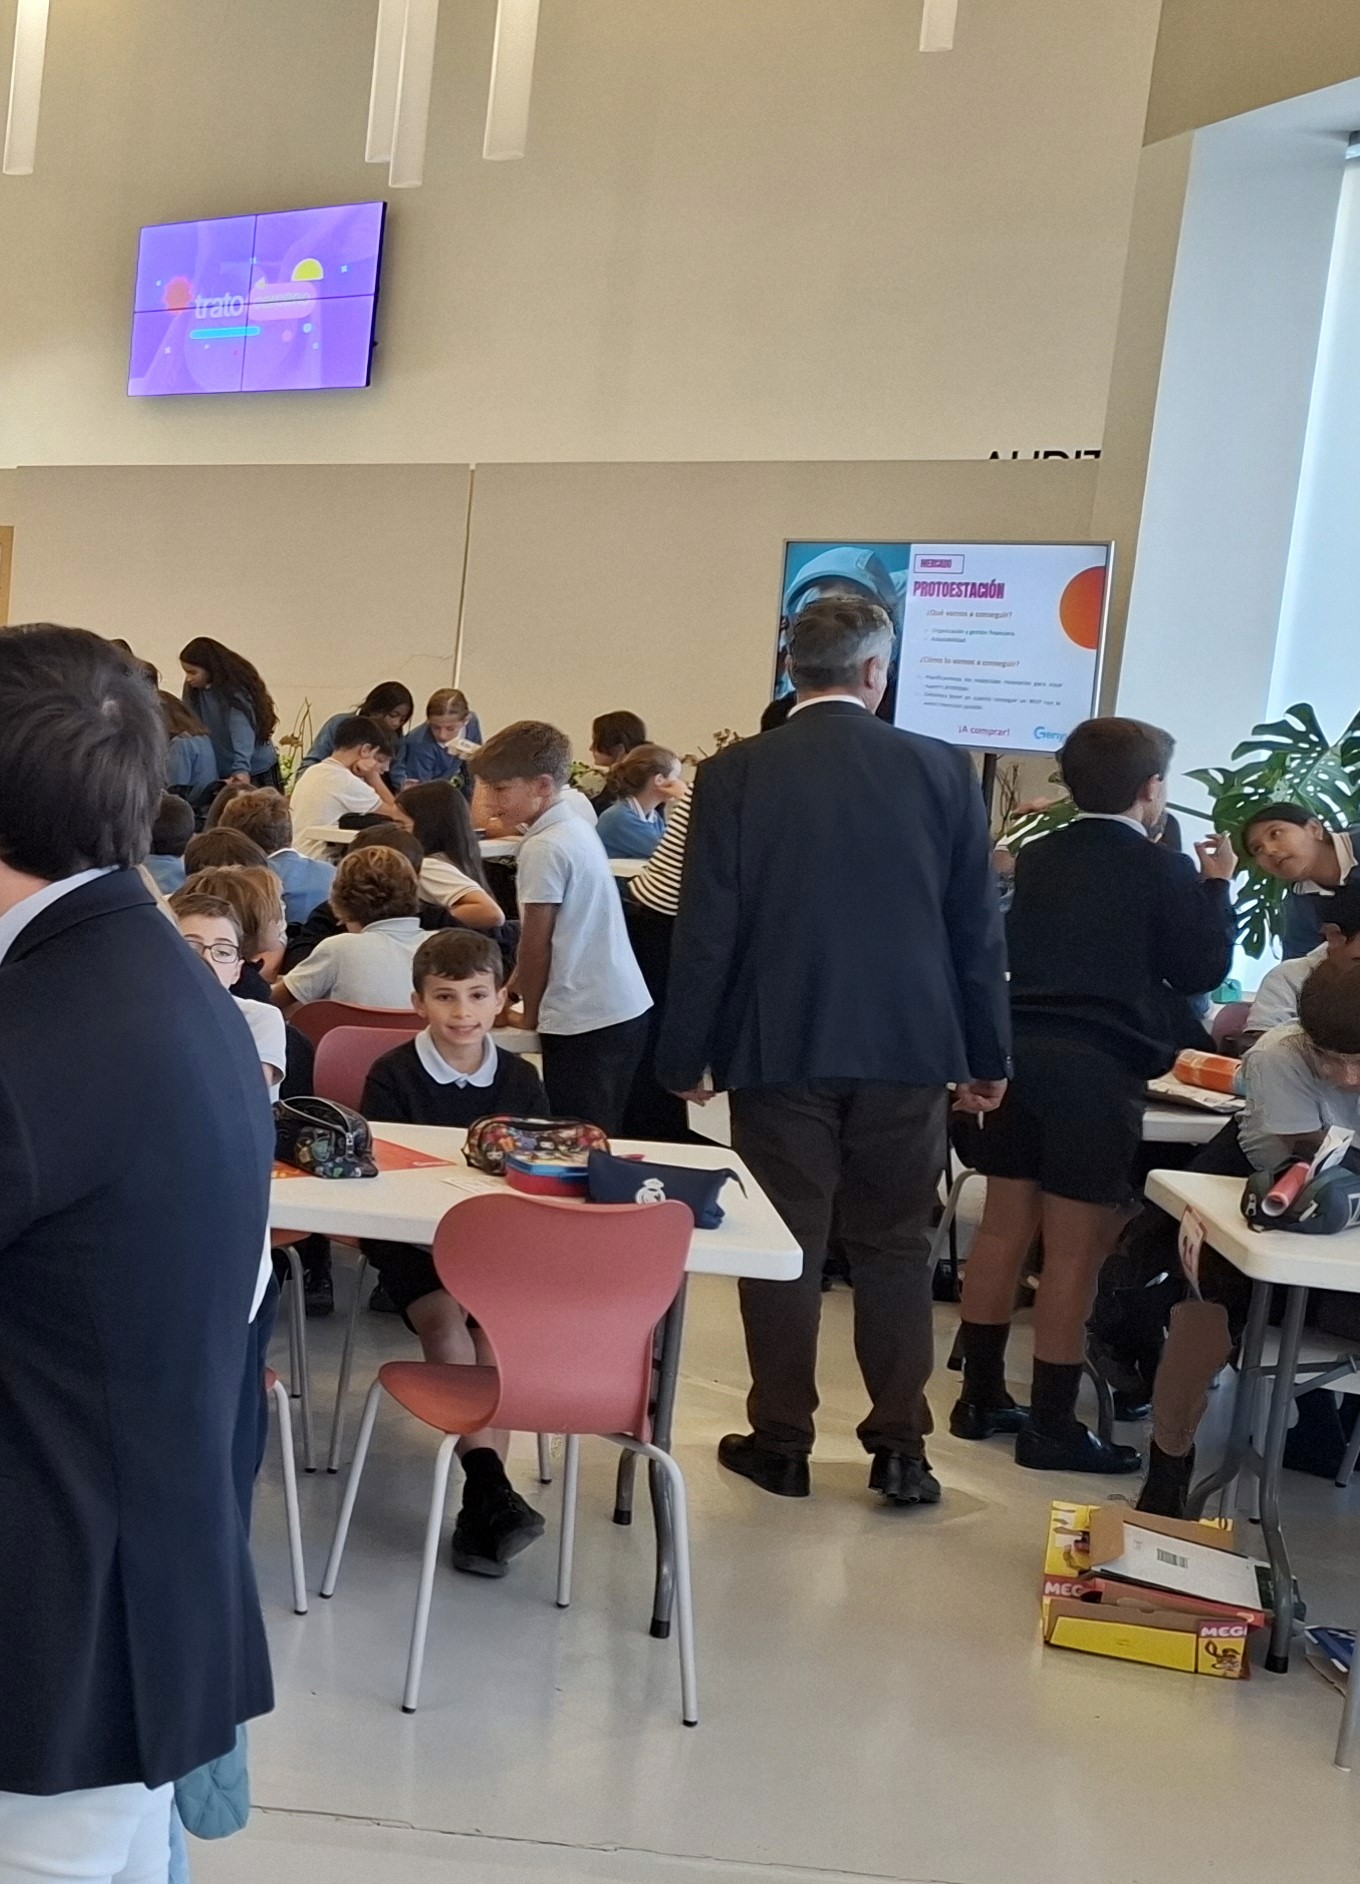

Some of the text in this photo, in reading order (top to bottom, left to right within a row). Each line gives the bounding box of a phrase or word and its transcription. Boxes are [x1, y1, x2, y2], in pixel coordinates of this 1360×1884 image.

[195, 292, 244, 319] trato
[913, 578, 1005, 599] PROTOESTACIÓN
[970, 727, 1010, 737] comprar!
[1034, 726, 1067, 743] Geny
